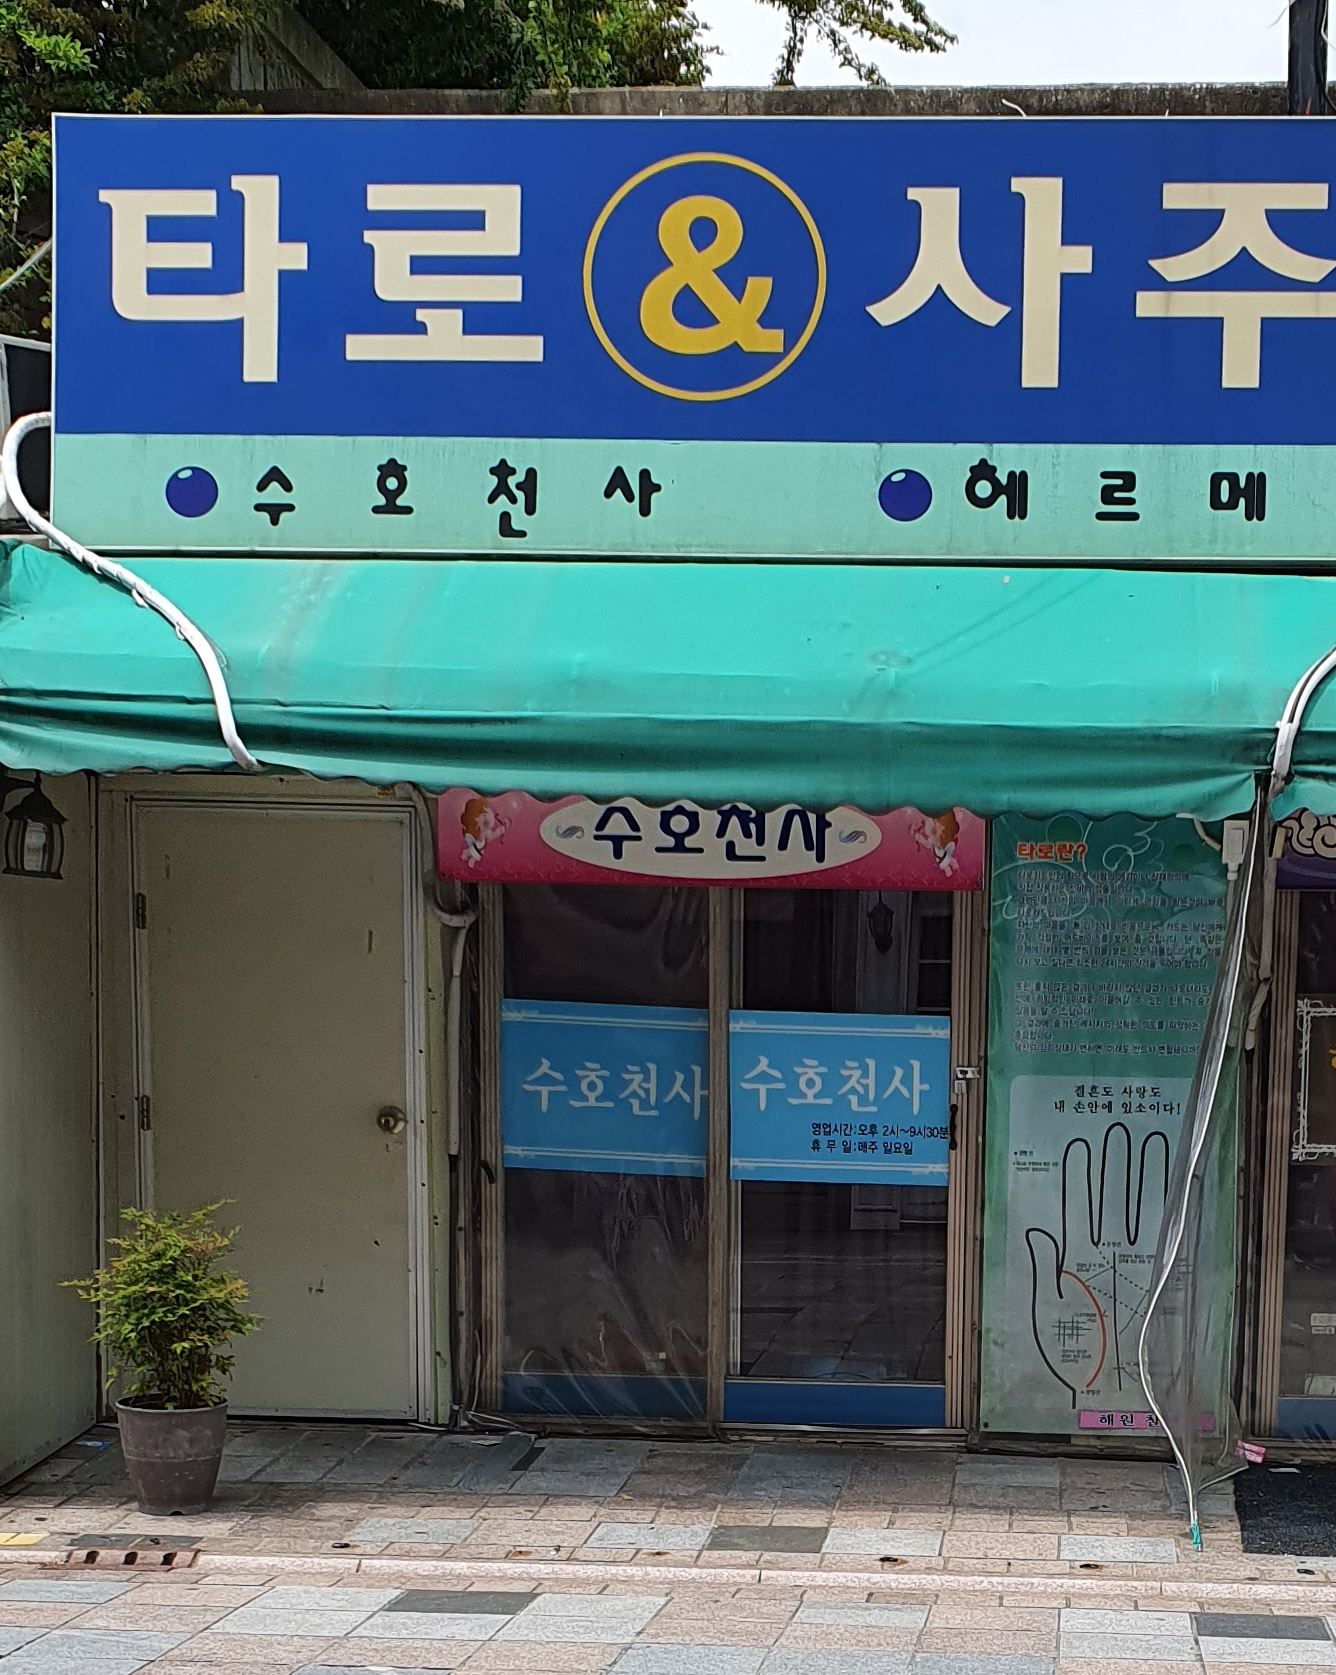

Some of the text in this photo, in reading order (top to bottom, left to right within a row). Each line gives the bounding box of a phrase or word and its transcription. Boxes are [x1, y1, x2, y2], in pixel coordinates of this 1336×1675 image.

[99, 175, 1336, 389] 타로 & 사주
[1017, 842, 1087, 861] 타로란?
[522, 1056, 708, 1122] 수호천사
[740, 1055, 930, 1116] 수호천사
